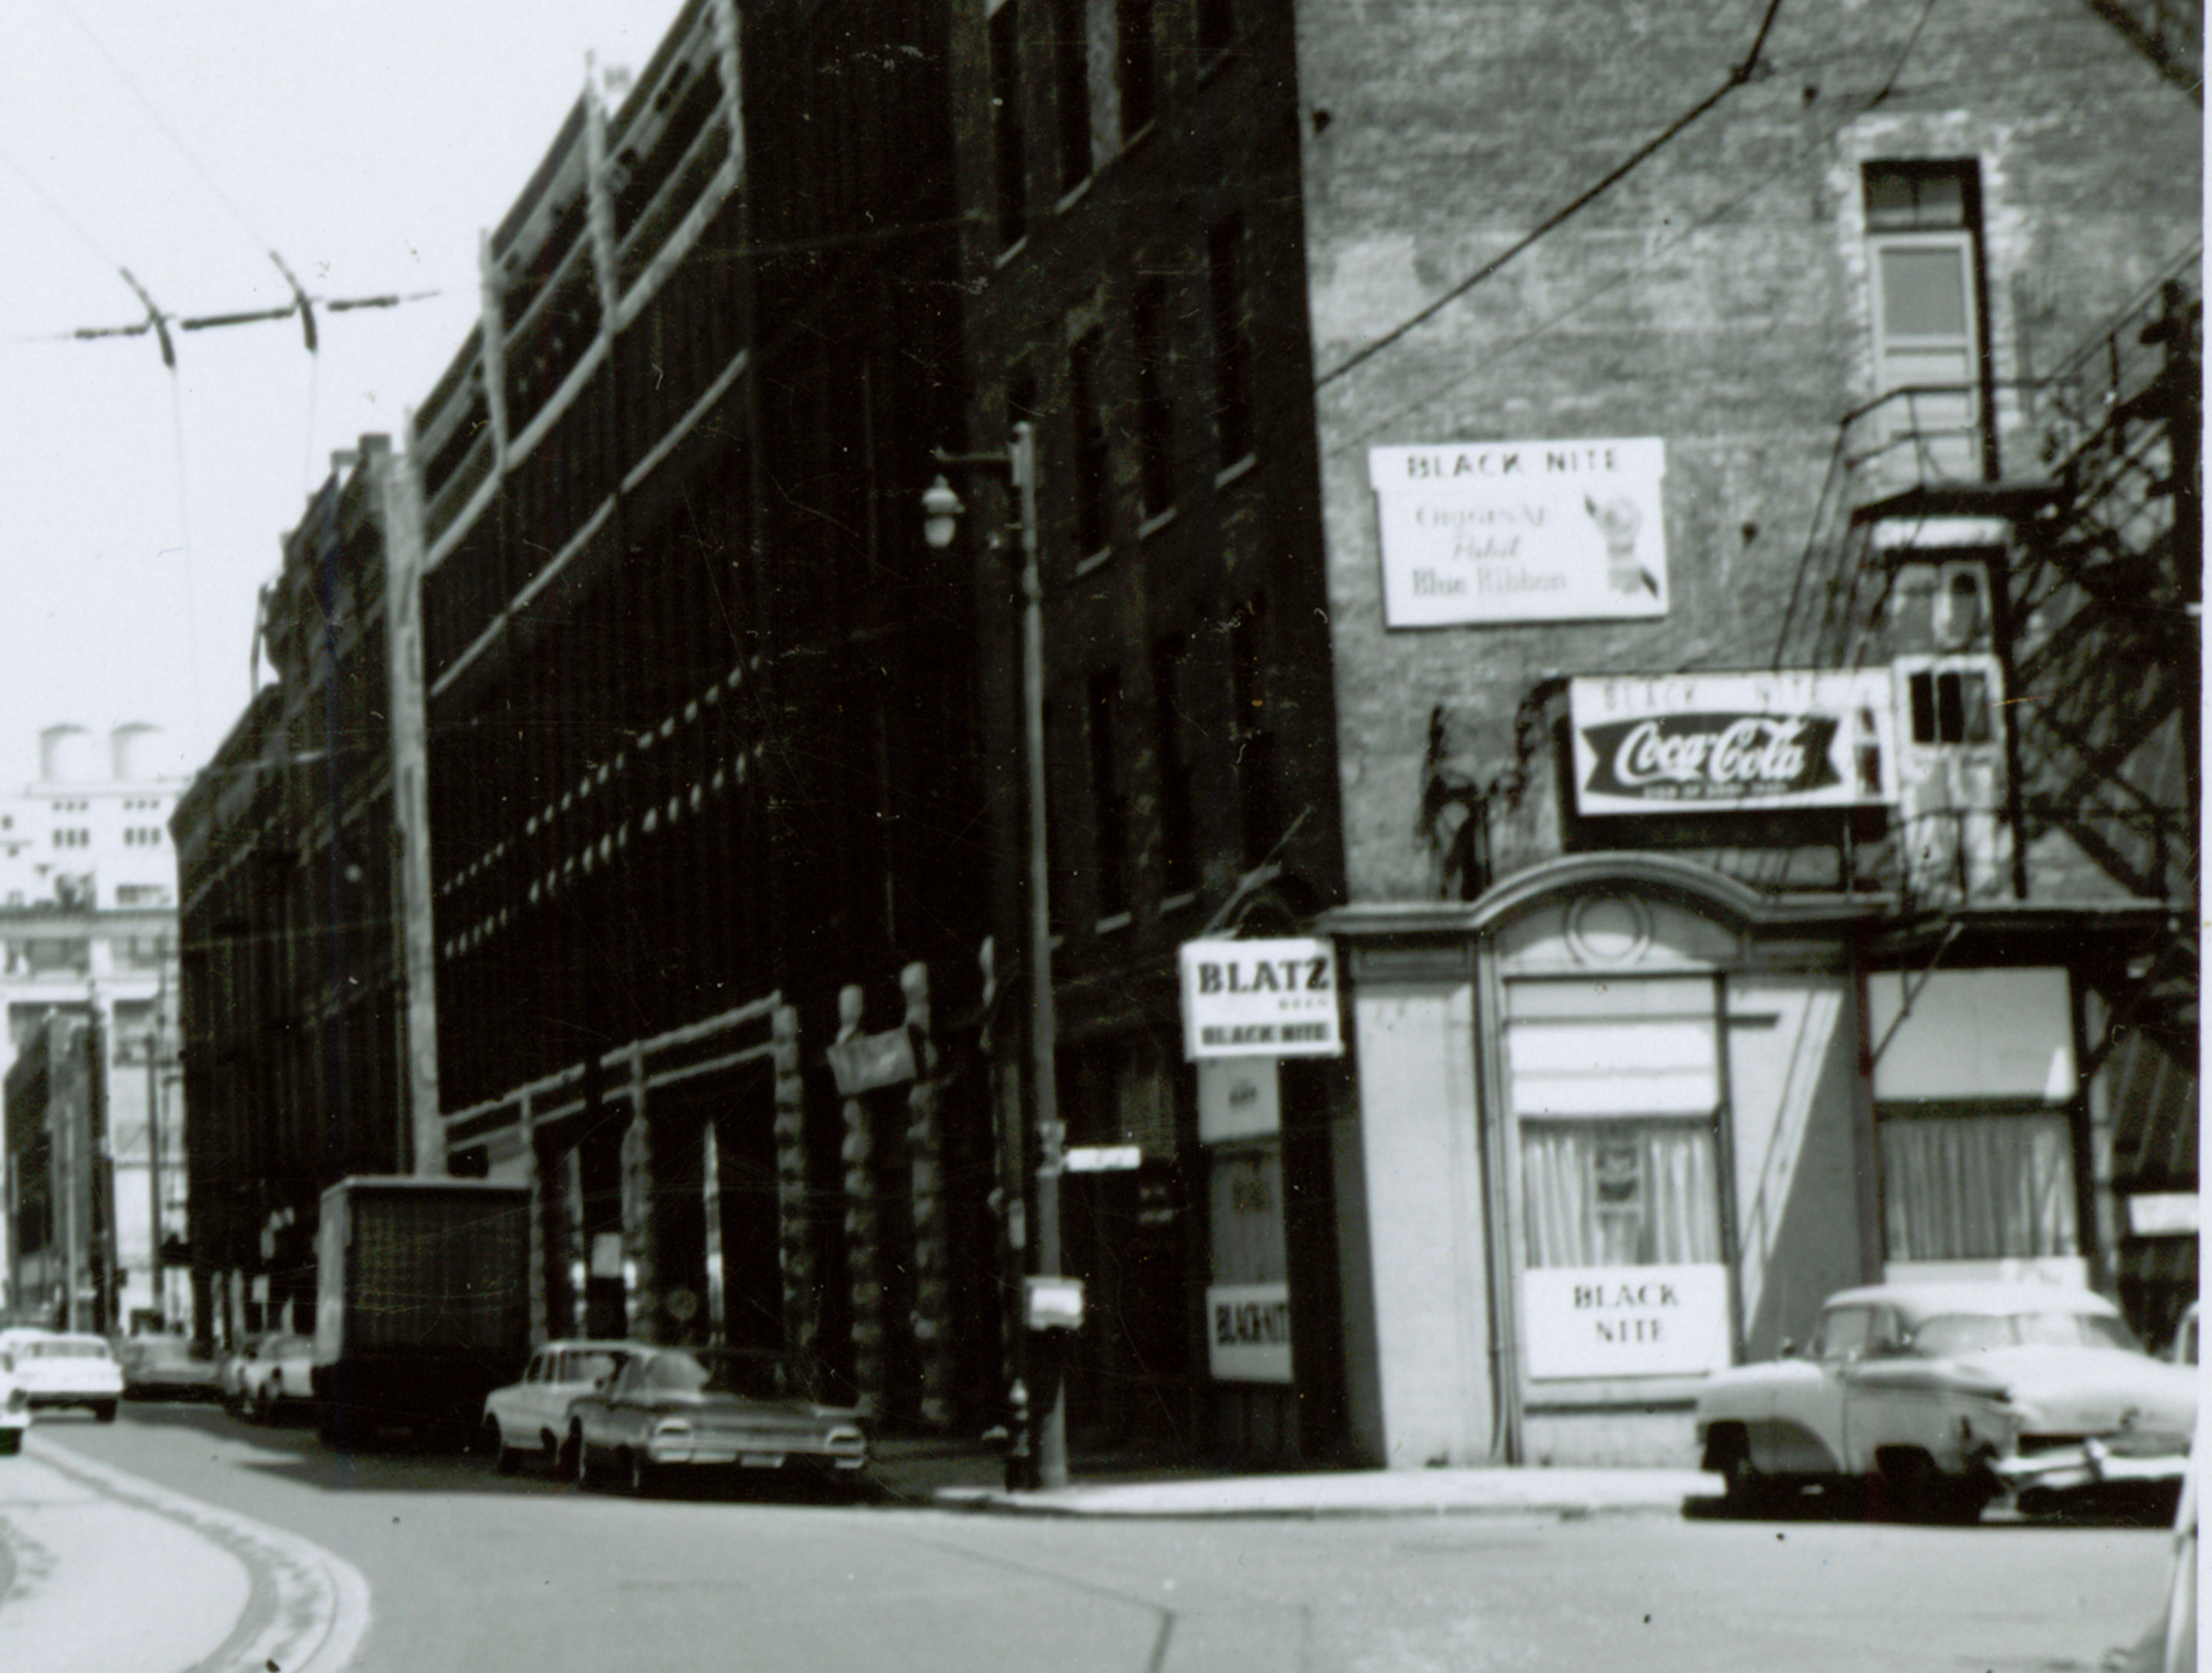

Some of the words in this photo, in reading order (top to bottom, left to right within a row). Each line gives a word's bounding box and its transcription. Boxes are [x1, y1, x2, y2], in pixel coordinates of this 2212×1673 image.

[1407, 452, 1523, 479] BLACK
[1545, 448, 1620, 473] NITE
[1413, 569, 1467, 596] Blue
[1477, 565, 1567, 593] Ribbon
[1198, 957, 1330, 994] BLATZ
[1201, 1024, 1273, 1045] BLACK
[1281, 1022, 1329, 1042] NITE
[1573, 1284, 1678, 1308] BLACK
[1596, 1319, 1662, 1342] NITE
